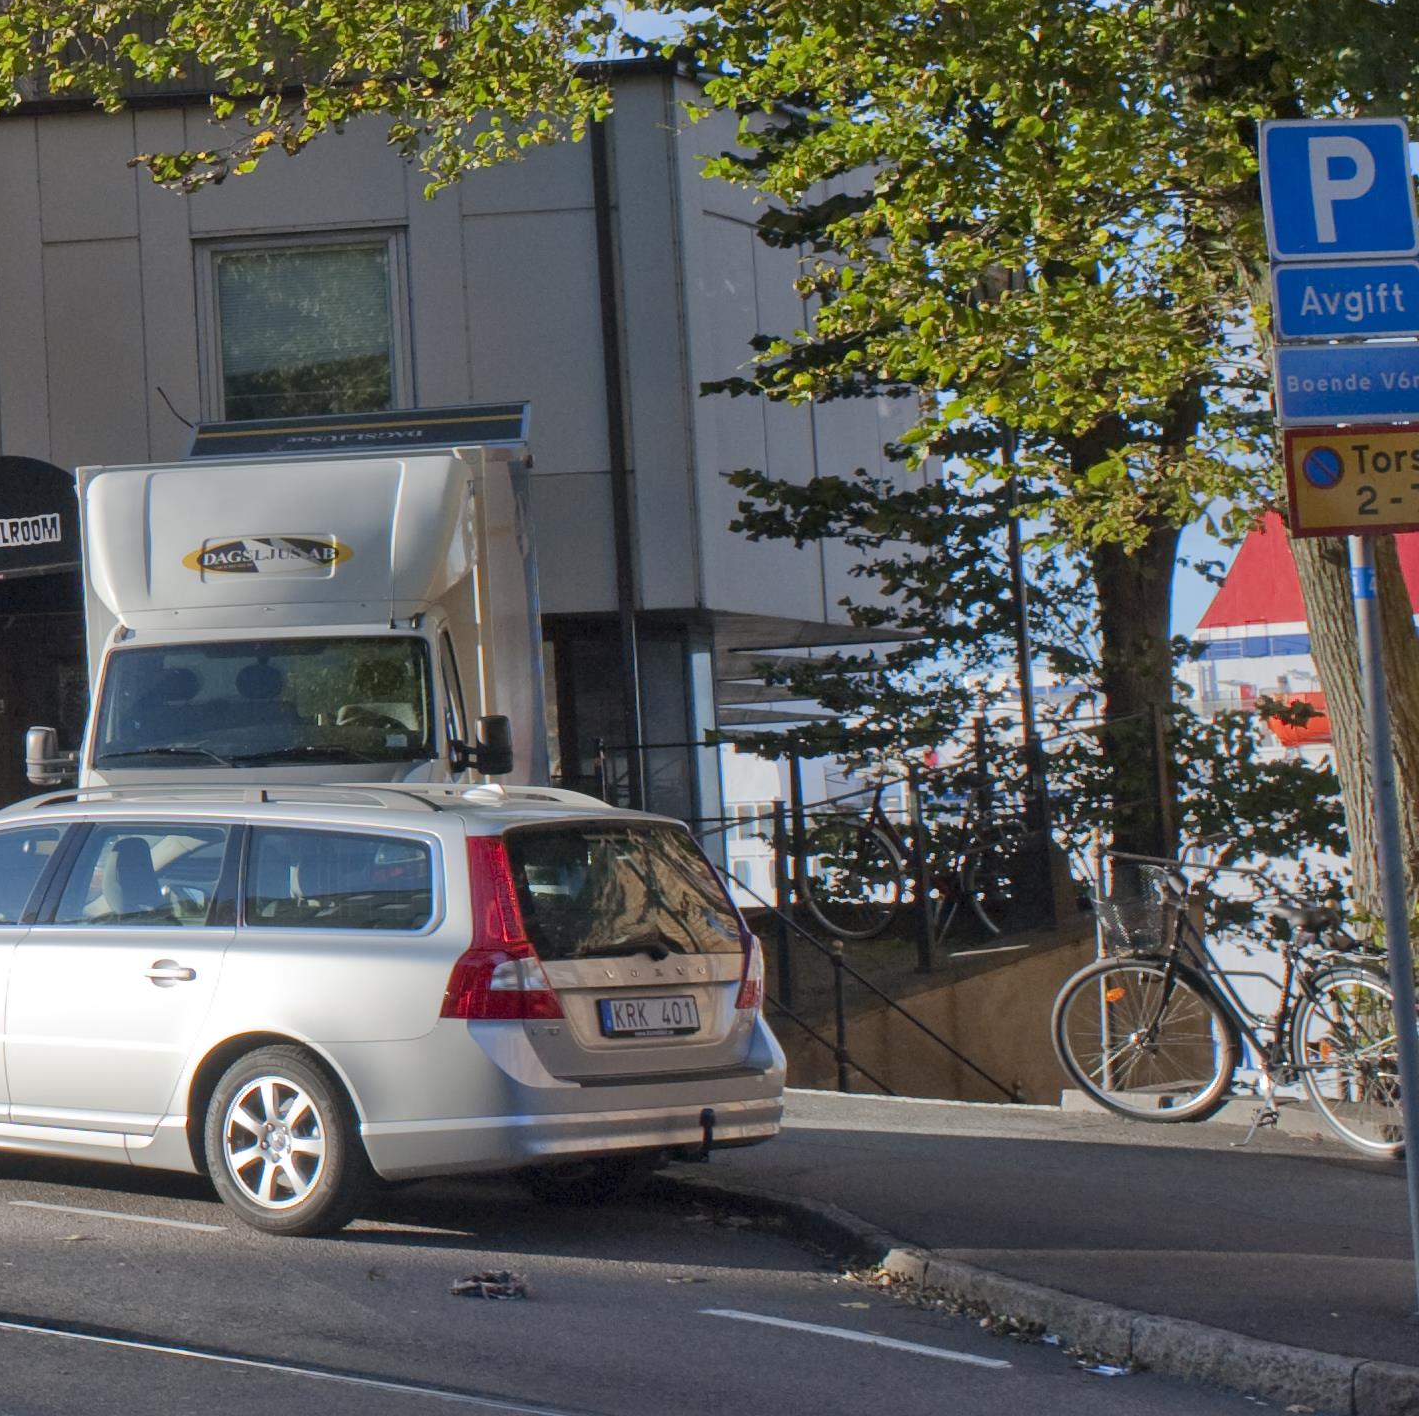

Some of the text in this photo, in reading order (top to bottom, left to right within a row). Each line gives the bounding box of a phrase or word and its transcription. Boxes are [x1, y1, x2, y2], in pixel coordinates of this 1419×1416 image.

[1308, 135, 1376, 243] P
[1301, 282, 1405, 322] Avgift
[1286, 372, 1372, 393] Boende
[202, 546, 336, 566] DAGSLJUS AB
[614, 1000, 694, 1028] KRK 401
